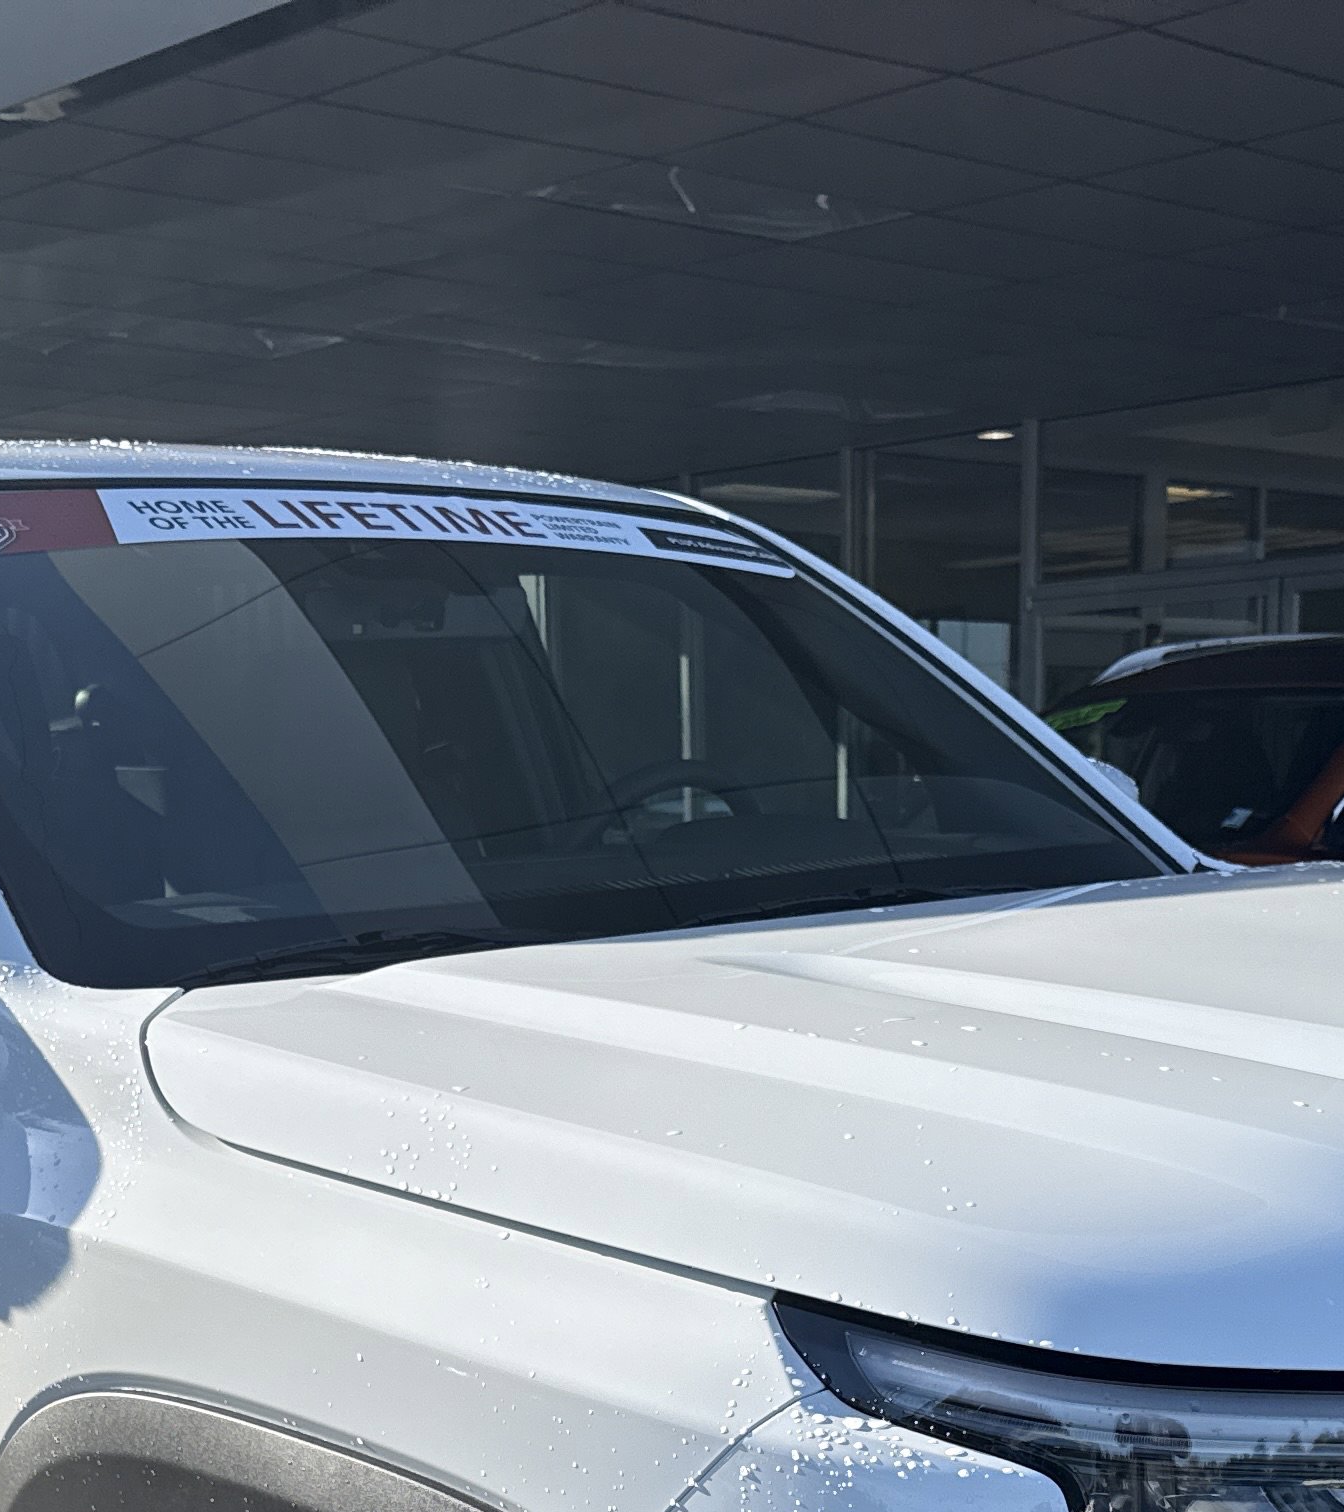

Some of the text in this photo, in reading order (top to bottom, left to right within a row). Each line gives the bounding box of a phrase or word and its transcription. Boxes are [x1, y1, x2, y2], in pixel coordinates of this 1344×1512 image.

[127, 500, 237, 515] HOME
[148, 515, 257, 530] OF THE
[241, 498, 549, 540] LIFETIME
[530, 513, 622, 530] POWERTRAIN
[543, 523, 600, 535] LIMITED
[553, 531, 631, 546] WARRANTY
